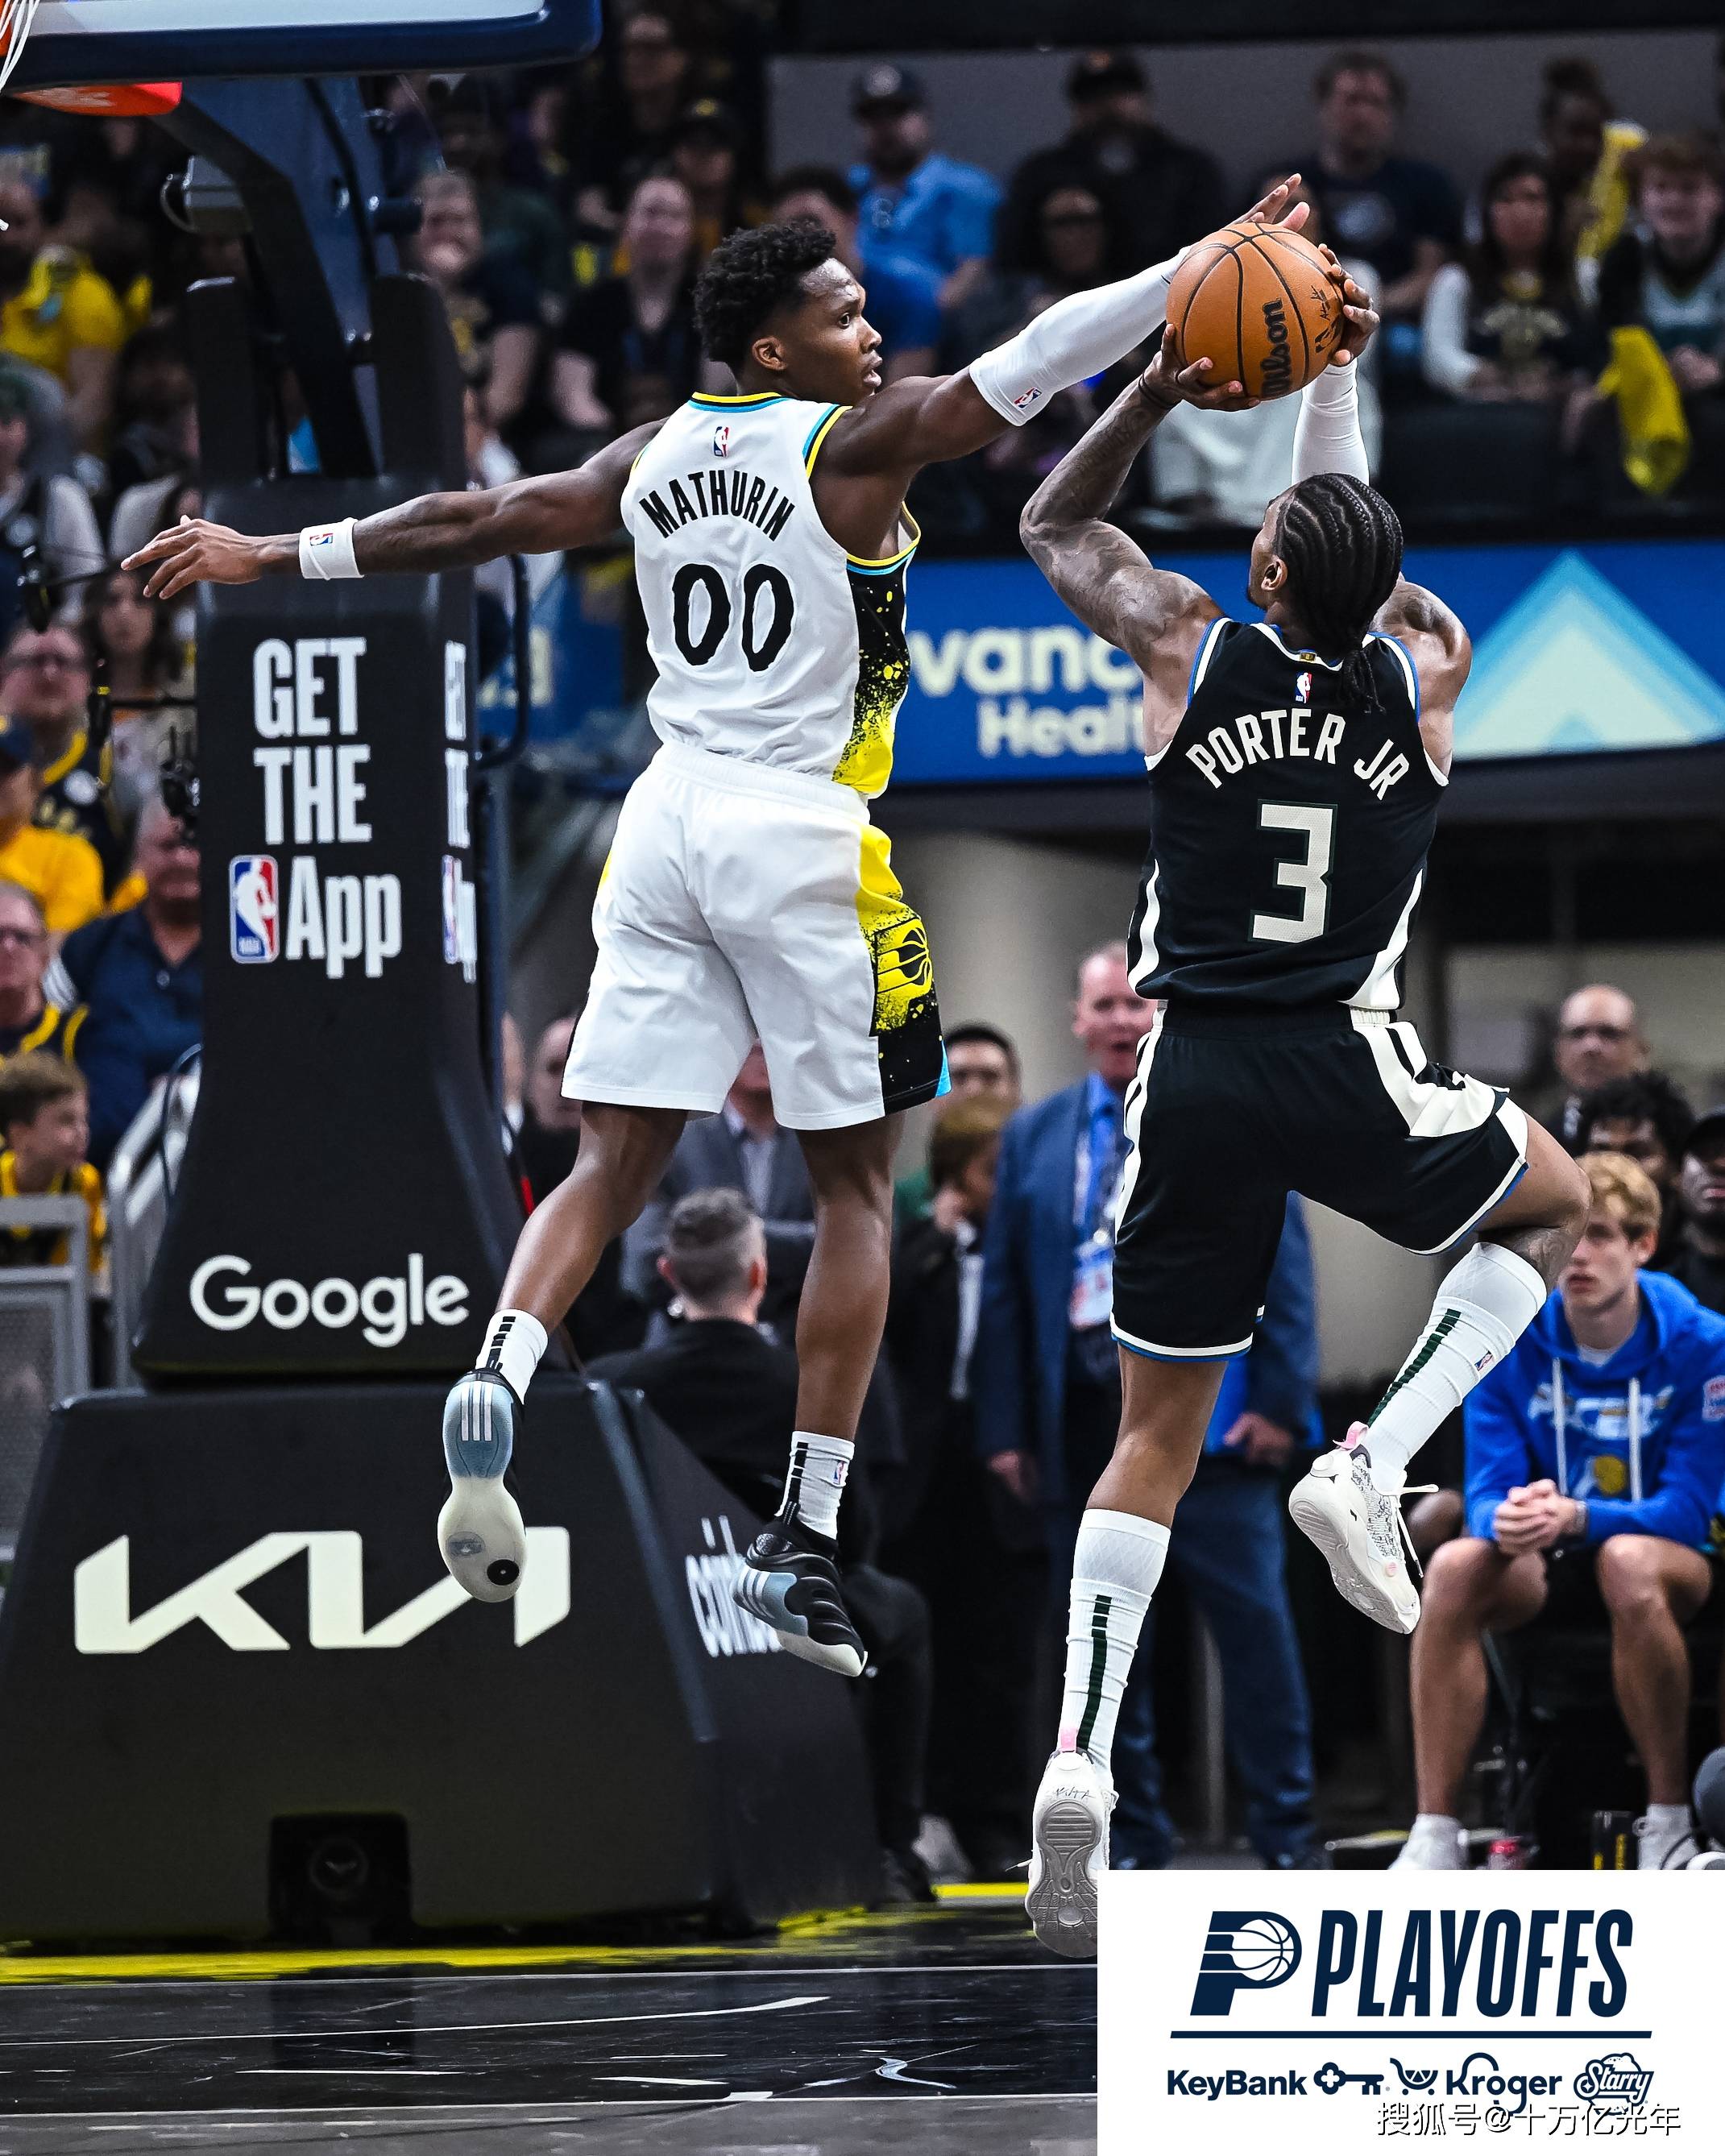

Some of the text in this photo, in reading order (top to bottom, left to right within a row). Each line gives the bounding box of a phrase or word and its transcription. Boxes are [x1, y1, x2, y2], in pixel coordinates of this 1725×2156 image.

[639, 470, 795, 542] MATHURIN
[672, 563, 795, 672] 00
[253, 636, 367, 739] GET
[253, 744, 372, 845] THE
[1185, 708, 1410, 801] PORTER JR
[285, 856, 402, 979] App
[1250, 802, 1336, 943] 3
[189, 1253, 470, 1348] Google
